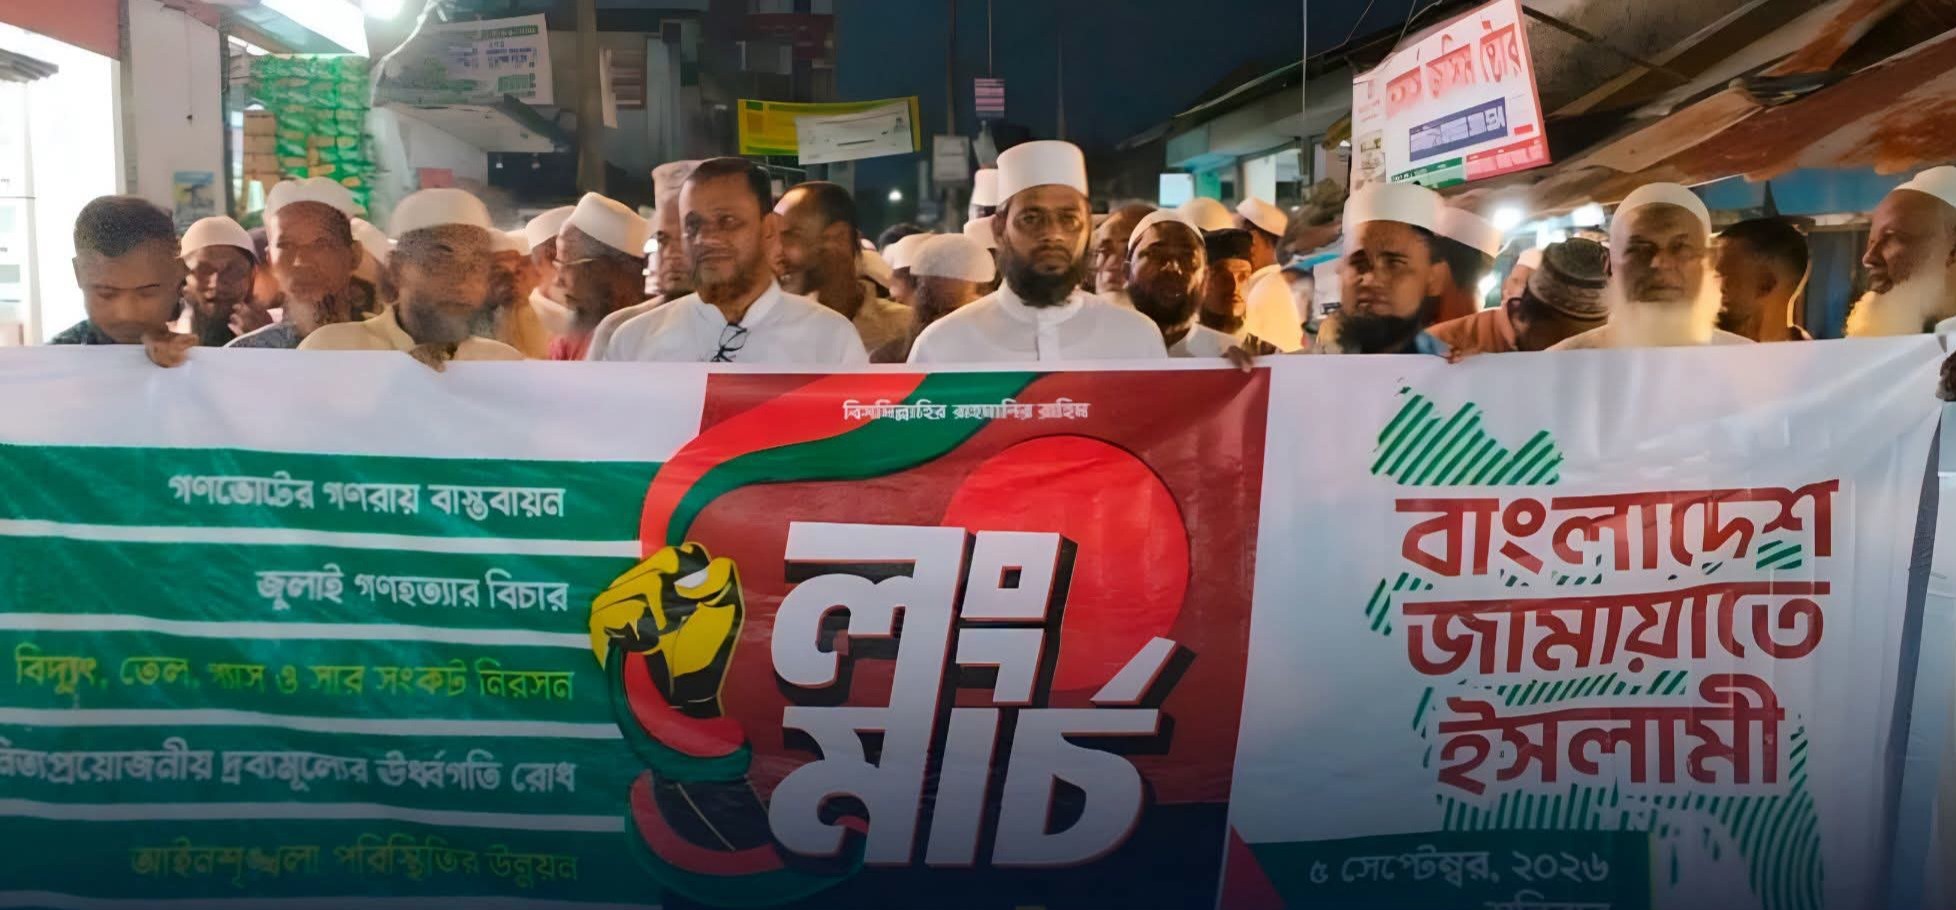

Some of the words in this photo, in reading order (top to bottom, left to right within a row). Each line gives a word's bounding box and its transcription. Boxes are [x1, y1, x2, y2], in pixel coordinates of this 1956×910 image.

[168, 470, 314, 511] গণভোটের
[322, 480, 420, 516] গণরায়
[428, 483, 567, 521] বাস্তবায়ন
[1395, 479, 1840, 577] বাংলাদেশ
[255, 564, 346, 611] জুলাই
[355, 574, 481, 608] গণহত্যার
[485, 568, 570, 612] বিচার
[770, 521, 1066, 703] লং
[1403, 581, 1831, 676] জামায়াতে
[276, 665, 297, 694] ও
[307, 665, 366, 695] সার
[371, 659, 467, 697] সংকট
[475, 657, 575, 700] নিরসন
[768, 636, 1177, 867] মার্চ
[1436, 673, 1786, 795] ইসলামী
[510, 760, 577, 793] রোধ
[483, 844, 578, 890] উন্নয়ন
[1309, 859, 1329, 884] ৫
[1511, 850, 1609, 883] ২০২৬
